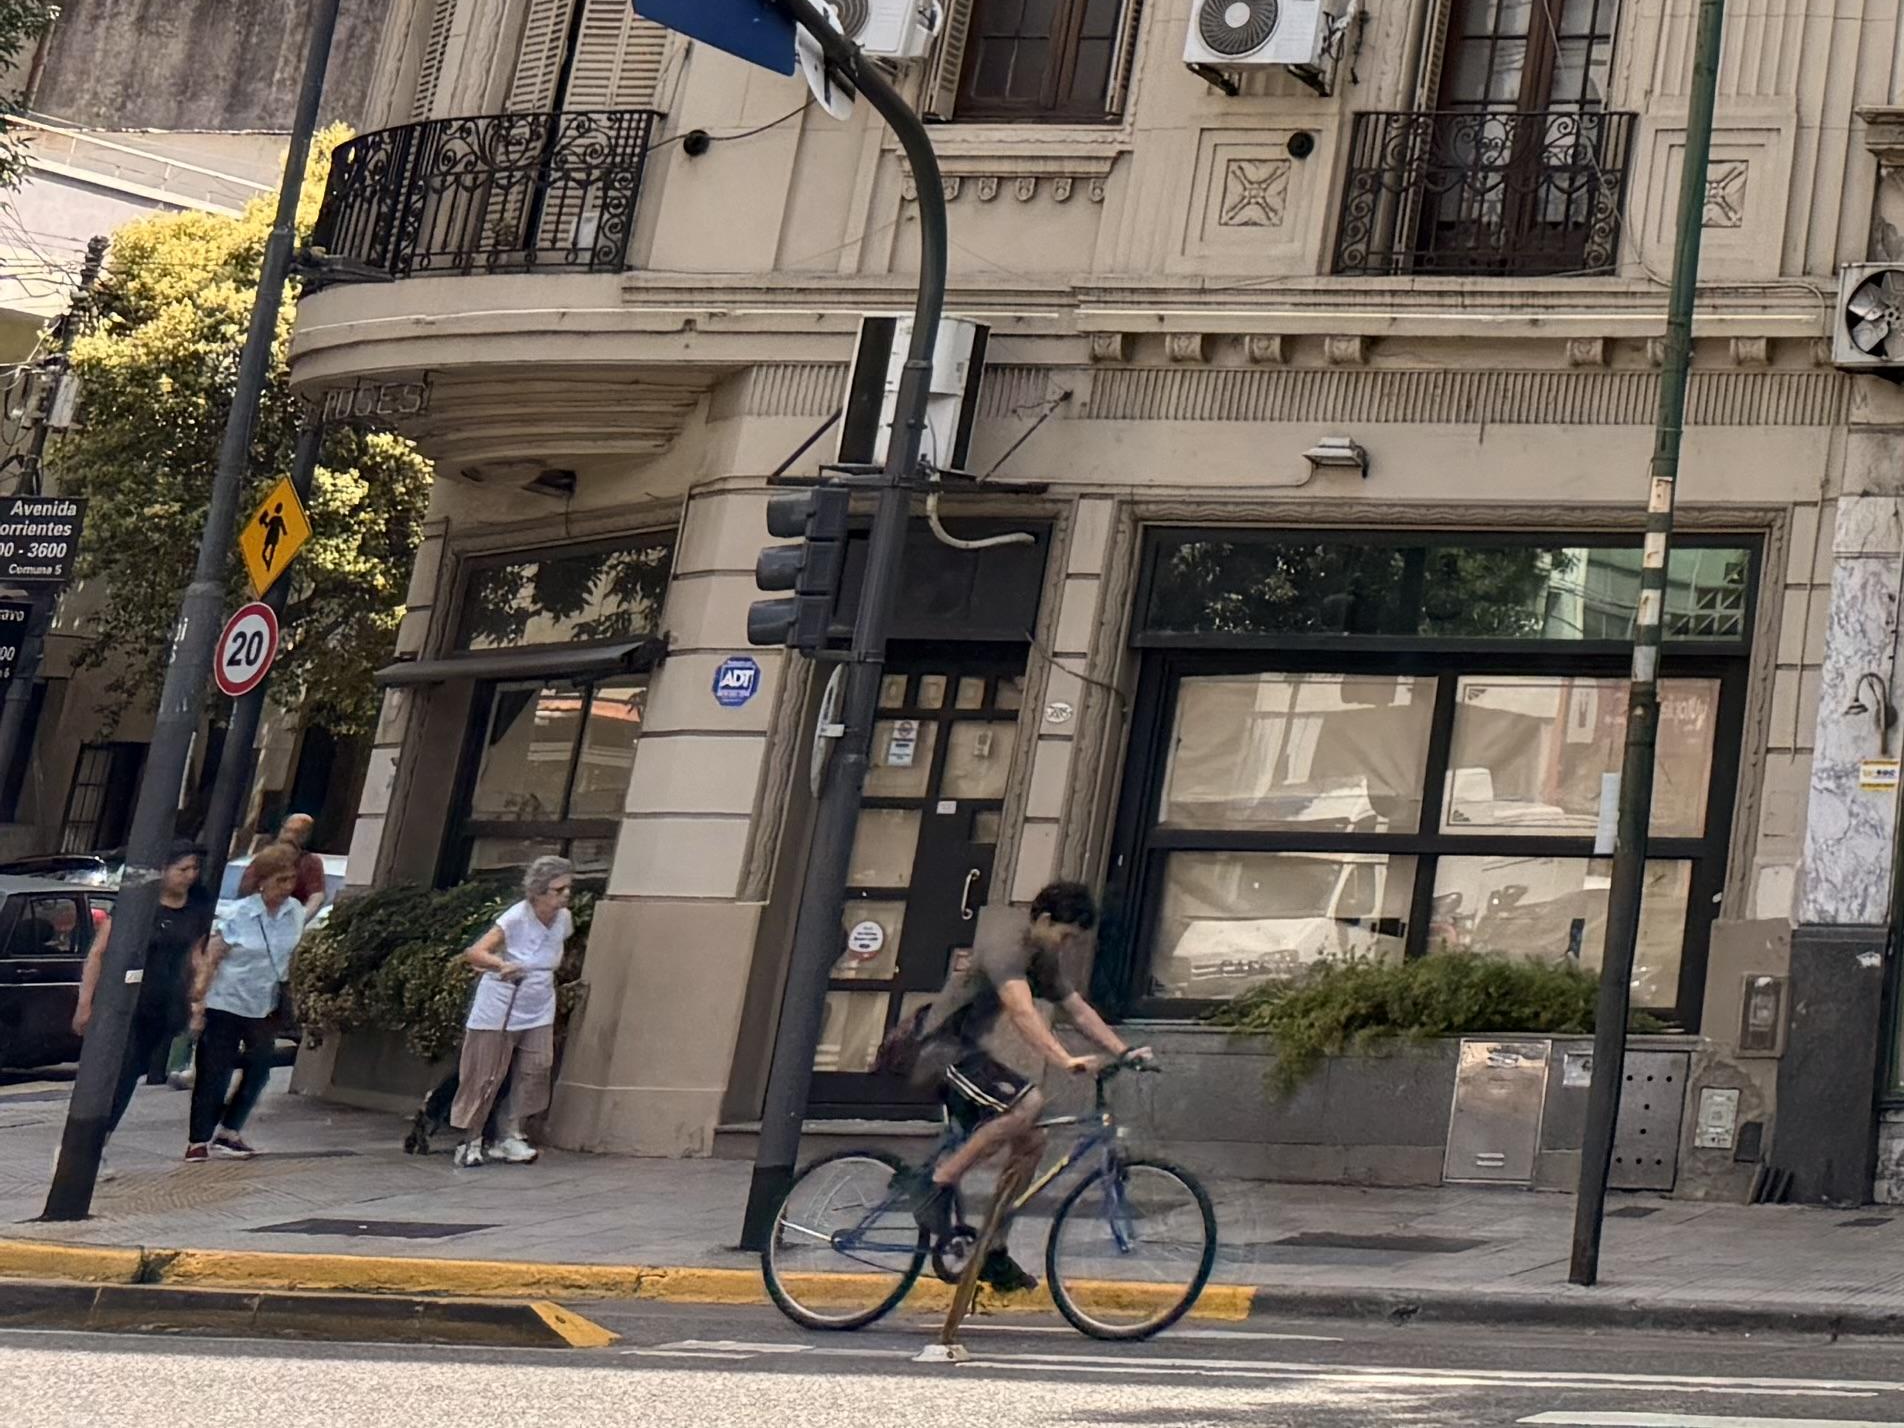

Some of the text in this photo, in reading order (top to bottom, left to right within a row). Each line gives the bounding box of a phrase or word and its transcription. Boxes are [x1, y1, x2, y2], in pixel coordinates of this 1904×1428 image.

[10, 500, 77, 516] Avenida
[0, 520, 72, 536] orrientes
[27, 542, 67, 558] 3600
[8, 563, 53, 575] Comuna
[226, 630, 264, 667] 20
[719, 669, 754, 687] ADT
